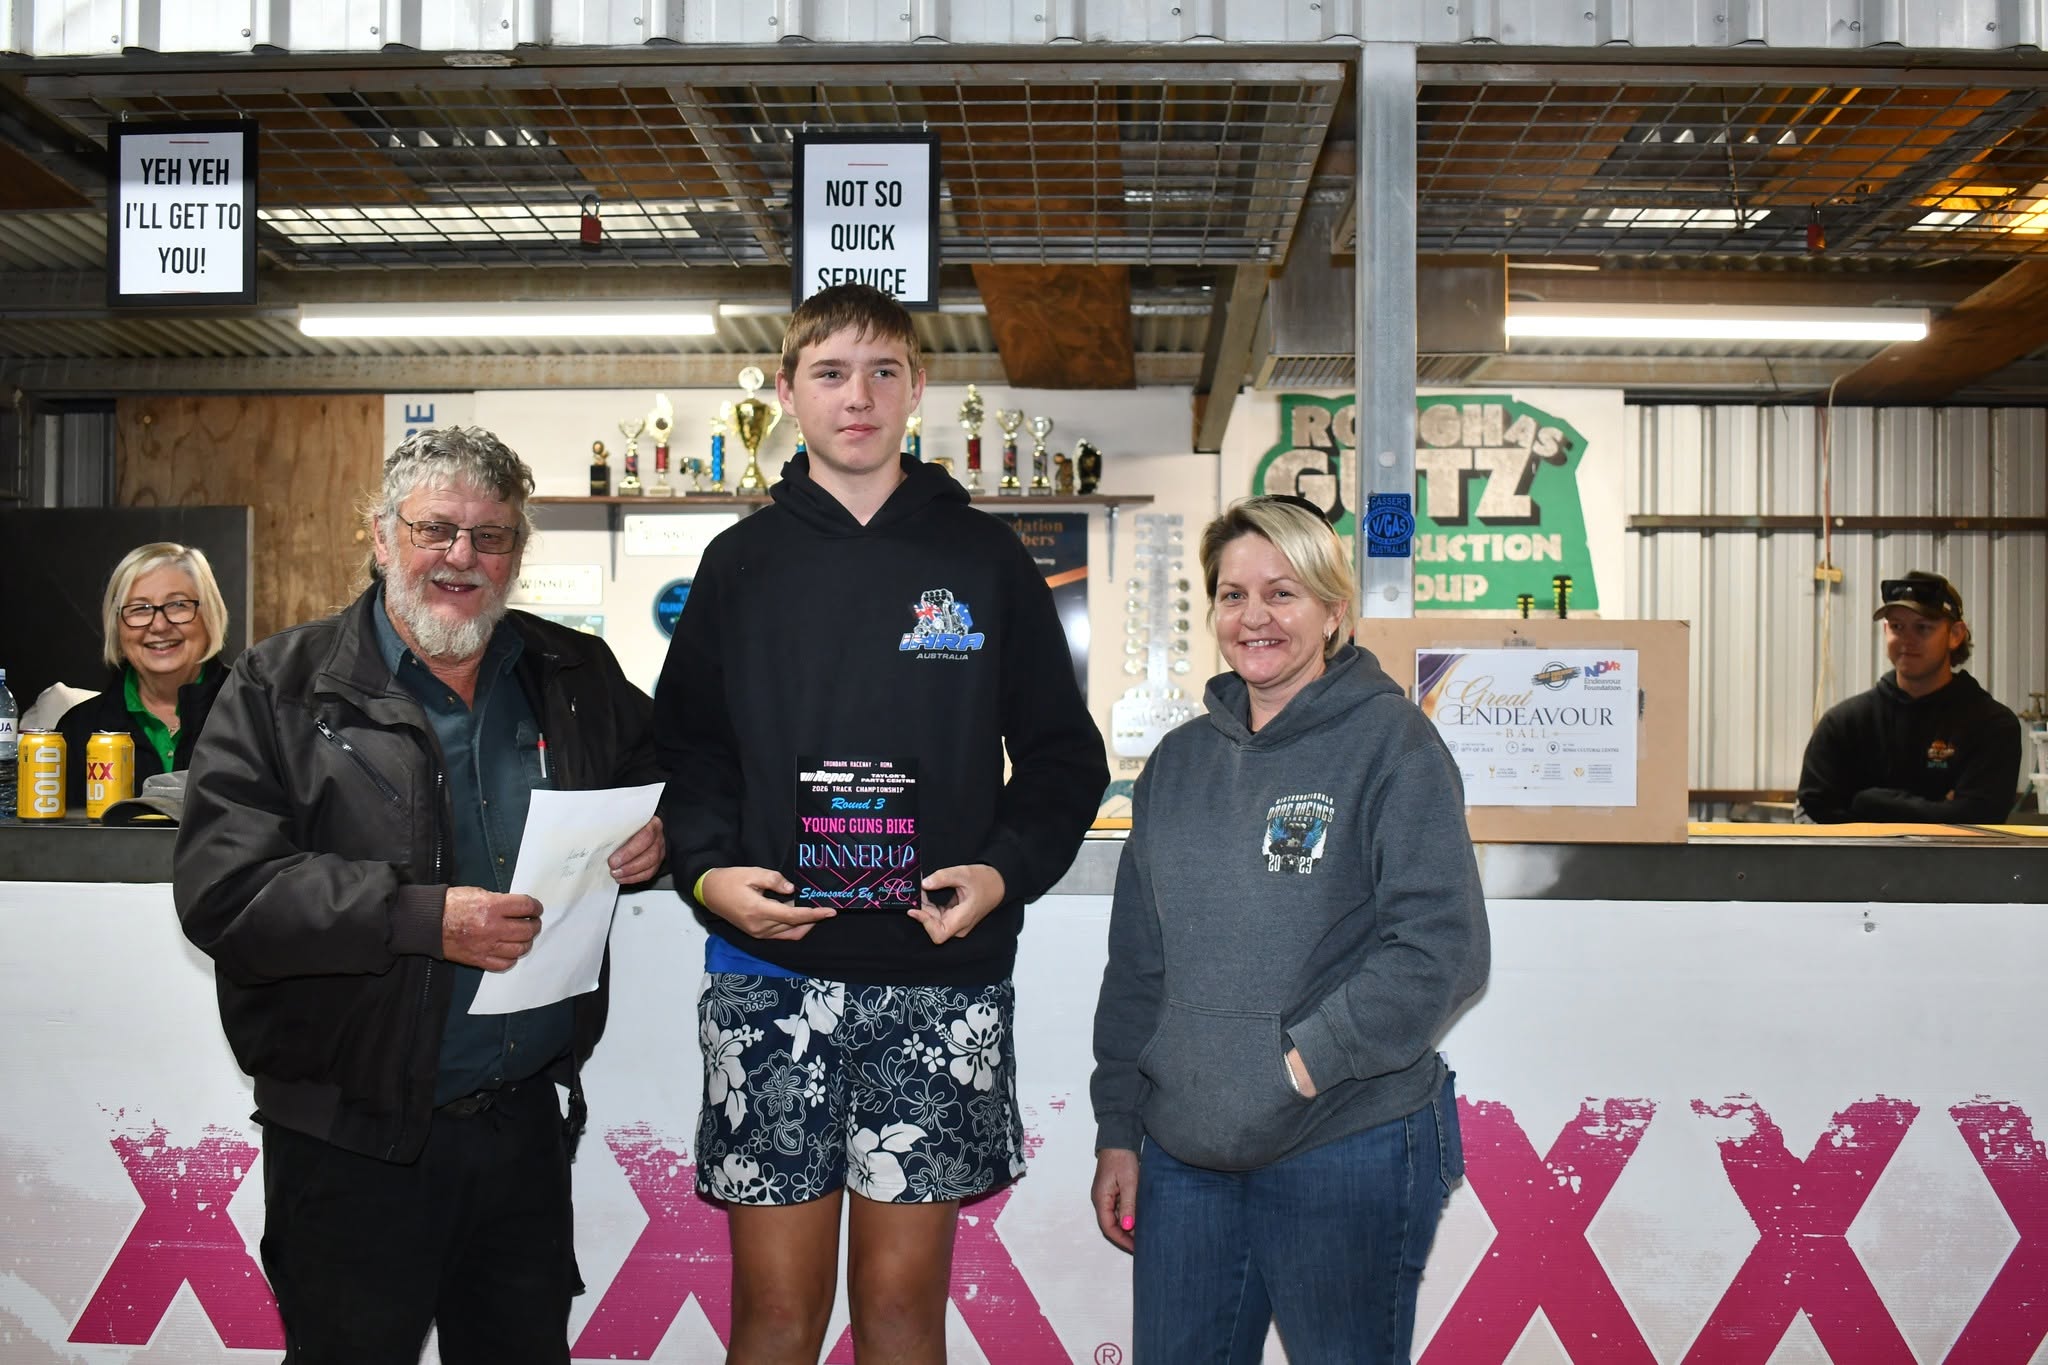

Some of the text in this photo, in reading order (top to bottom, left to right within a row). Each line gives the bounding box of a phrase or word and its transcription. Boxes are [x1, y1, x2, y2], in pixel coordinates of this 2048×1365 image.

[141, 159, 229, 185] YEH YEH
[826, 180, 902, 207] NOT SO
[126, 203, 241, 230] I'LL GET TO
[831, 224, 895, 251] QUICK
[158, 247, 205, 274] YOU!
[818, 267, 907, 295] SERVICE
[1291, 404, 1502, 448] ROGH
[1371, 497, 1408, 509] GASSERS
[1013, 518, 1064, 533] dation
[1021, 533, 1056, 546] bers
[1370, 542, 1408, 554] AUSTRALIA
[1415, 574, 1489, 602] OUP
[916, 652, 969, 660] AUSTRALIA
[1445, 675, 1534, 712] Great
[1438, 706, 1614, 726] ENDEAVOUR
[1505, 728, 1548, 739] BALL
[33, 746, 61, 814] GOLD
[88, 762, 114, 780] XX
[813, 770, 855, 784] Repco
[88, 783, 104, 800] LD
[832, 785, 853, 793] TRACK
[855, 786, 905, 794] CHAMPIONSHIP
[831, 797, 886, 810] Round 3
[1266, 801, 1335, 823] DRAG RACINGS
[801, 817, 915, 834] YOUNG GUNS BIKE
[799, 843, 915, 868] RUNNER UP
[1268, 854, 1313, 874] 20 23
[799, 887, 855, 900] Sponsored
[857, 886, 874, 900] By
